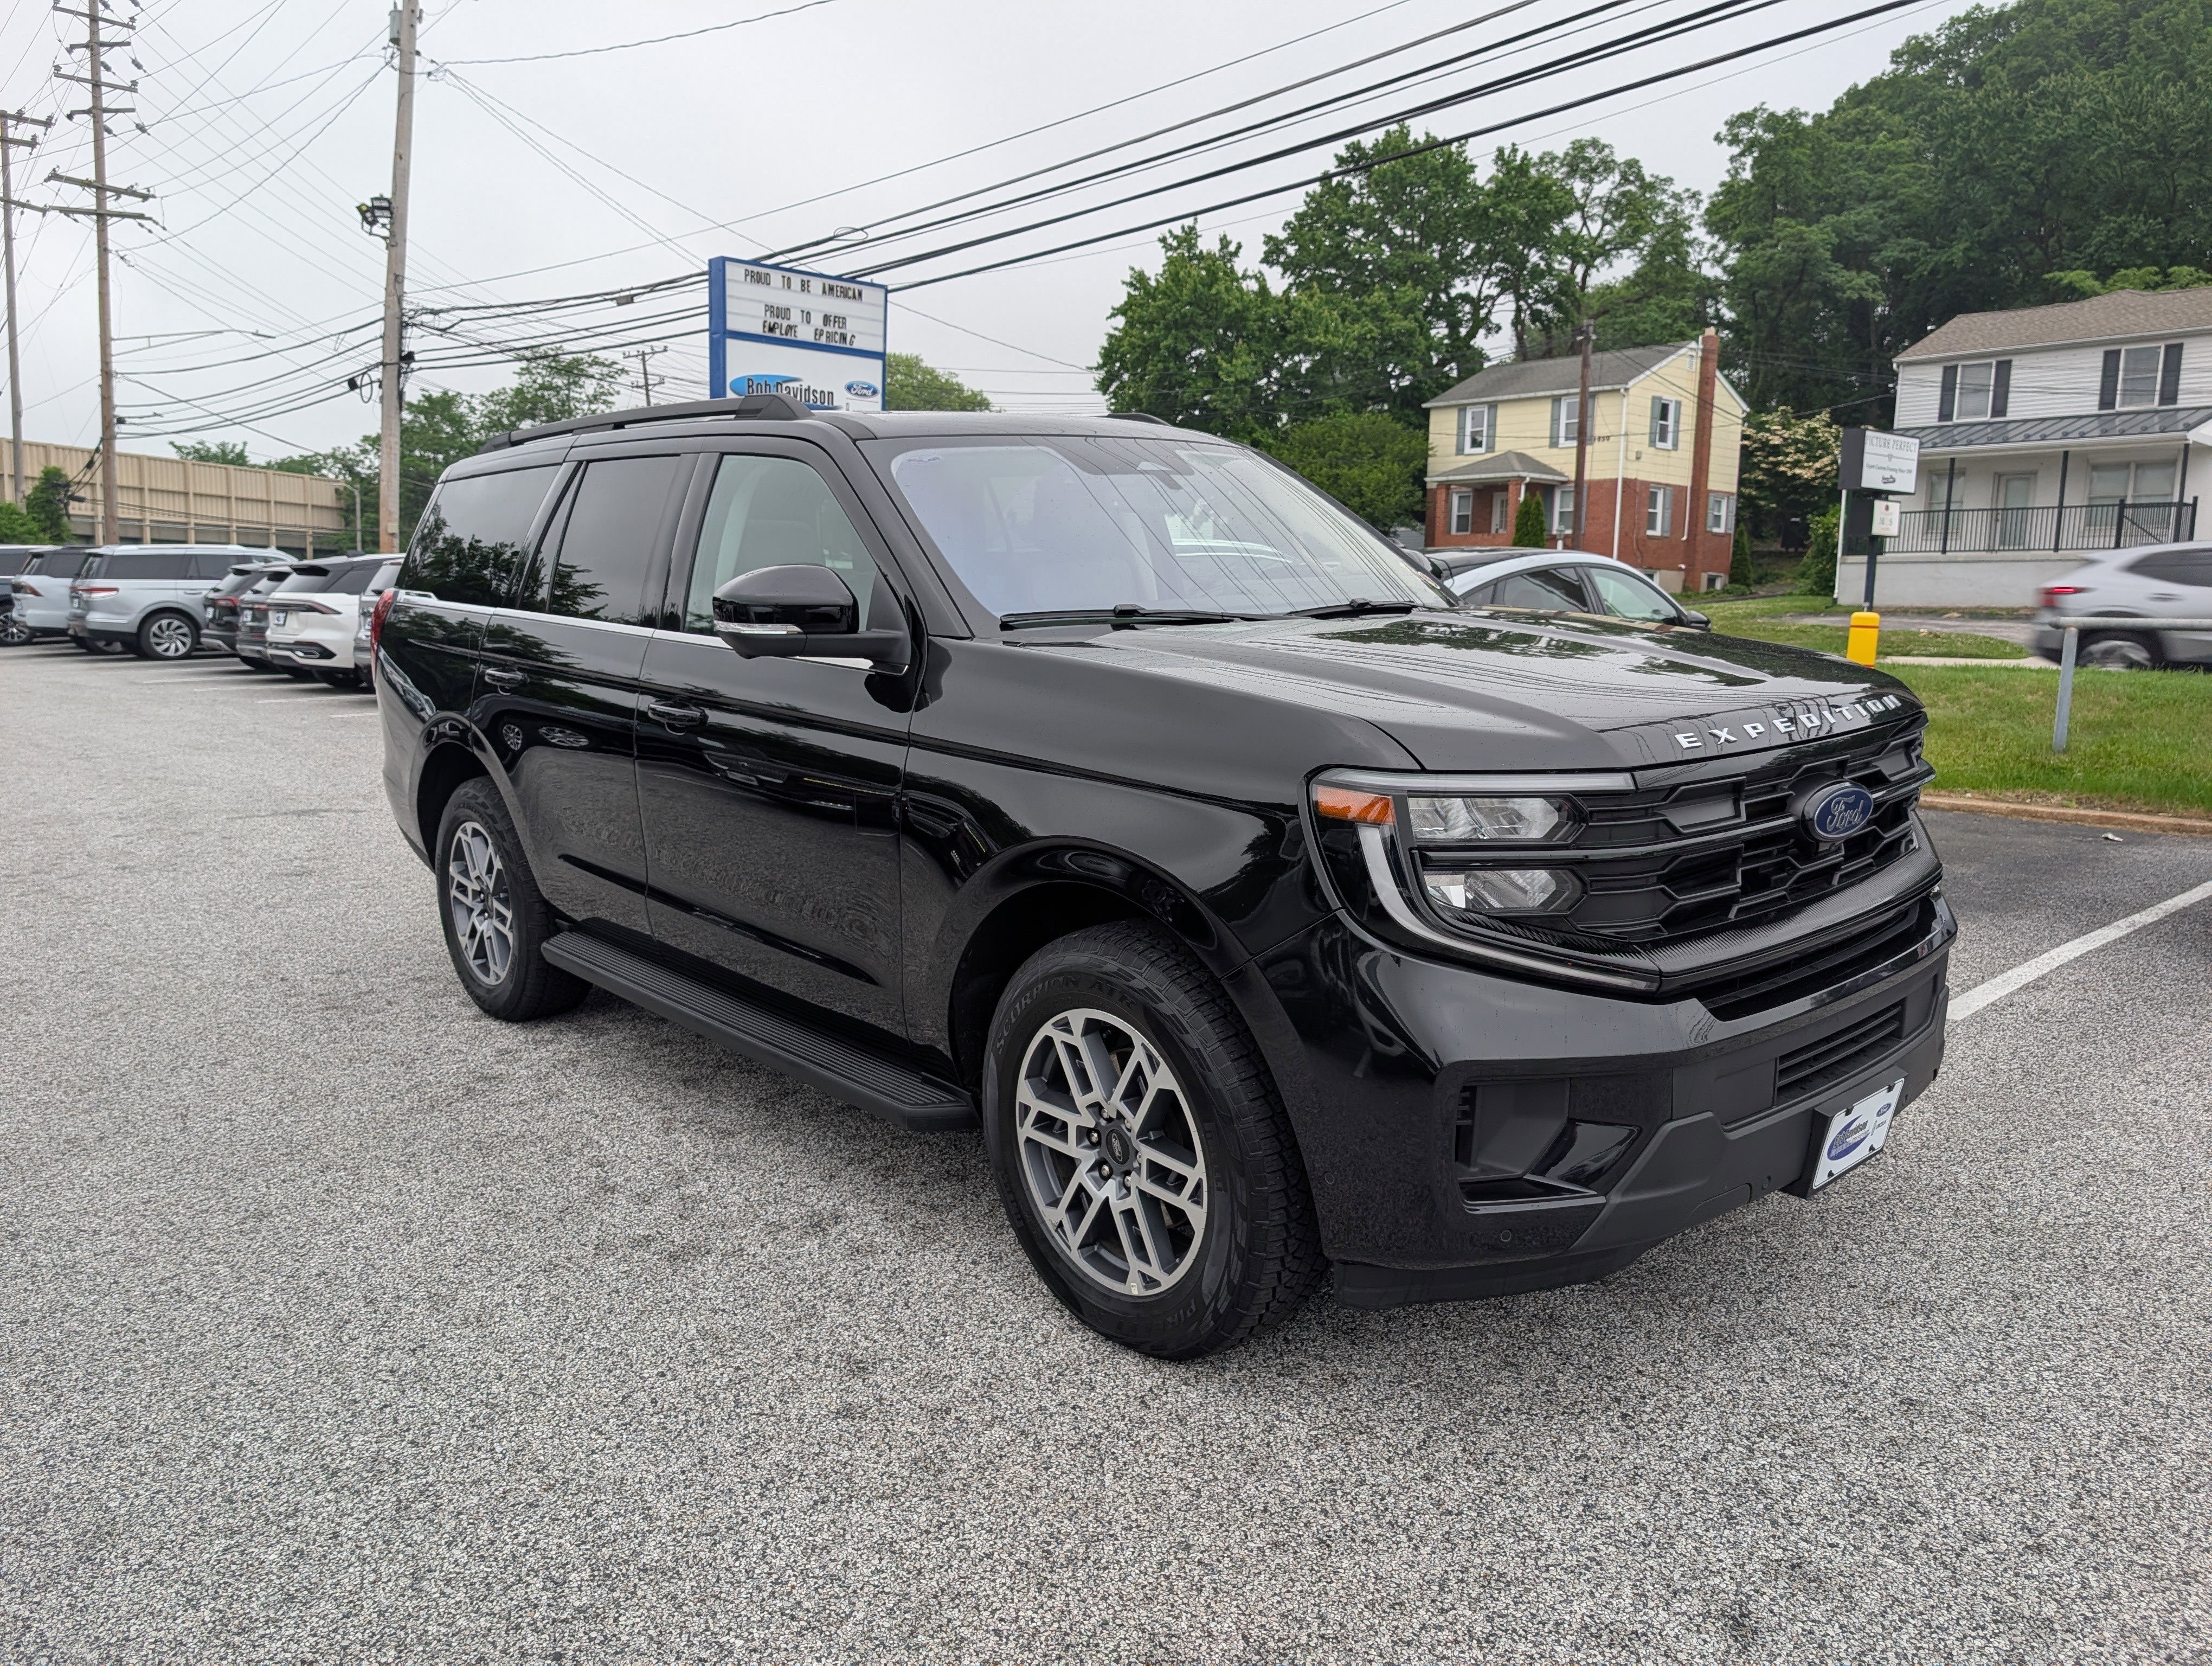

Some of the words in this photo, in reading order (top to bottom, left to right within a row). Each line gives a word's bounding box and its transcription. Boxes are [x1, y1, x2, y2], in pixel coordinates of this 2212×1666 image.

[744, 269, 771, 285] PROUD
[781, 275, 792, 290] TO
[801, 279, 811, 293] BE
[822, 282, 863, 302] AMERICAN
[764, 304, 790, 321] PROUD
[801, 310, 811, 324] TO
[823, 313, 847, 329] OFFER
[850, 383, 874, 396] Ford
[1865, 435, 1891, 449] PICTURE
[1892, 439, 1918, 453] PERFECT
[1674, 695, 1902, 749] EXPEDITION
[1826, 795, 1864, 832] Ford
[996, 975, 1081, 1054] SCORPION
[1089, 979, 1136, 1010] ATR
